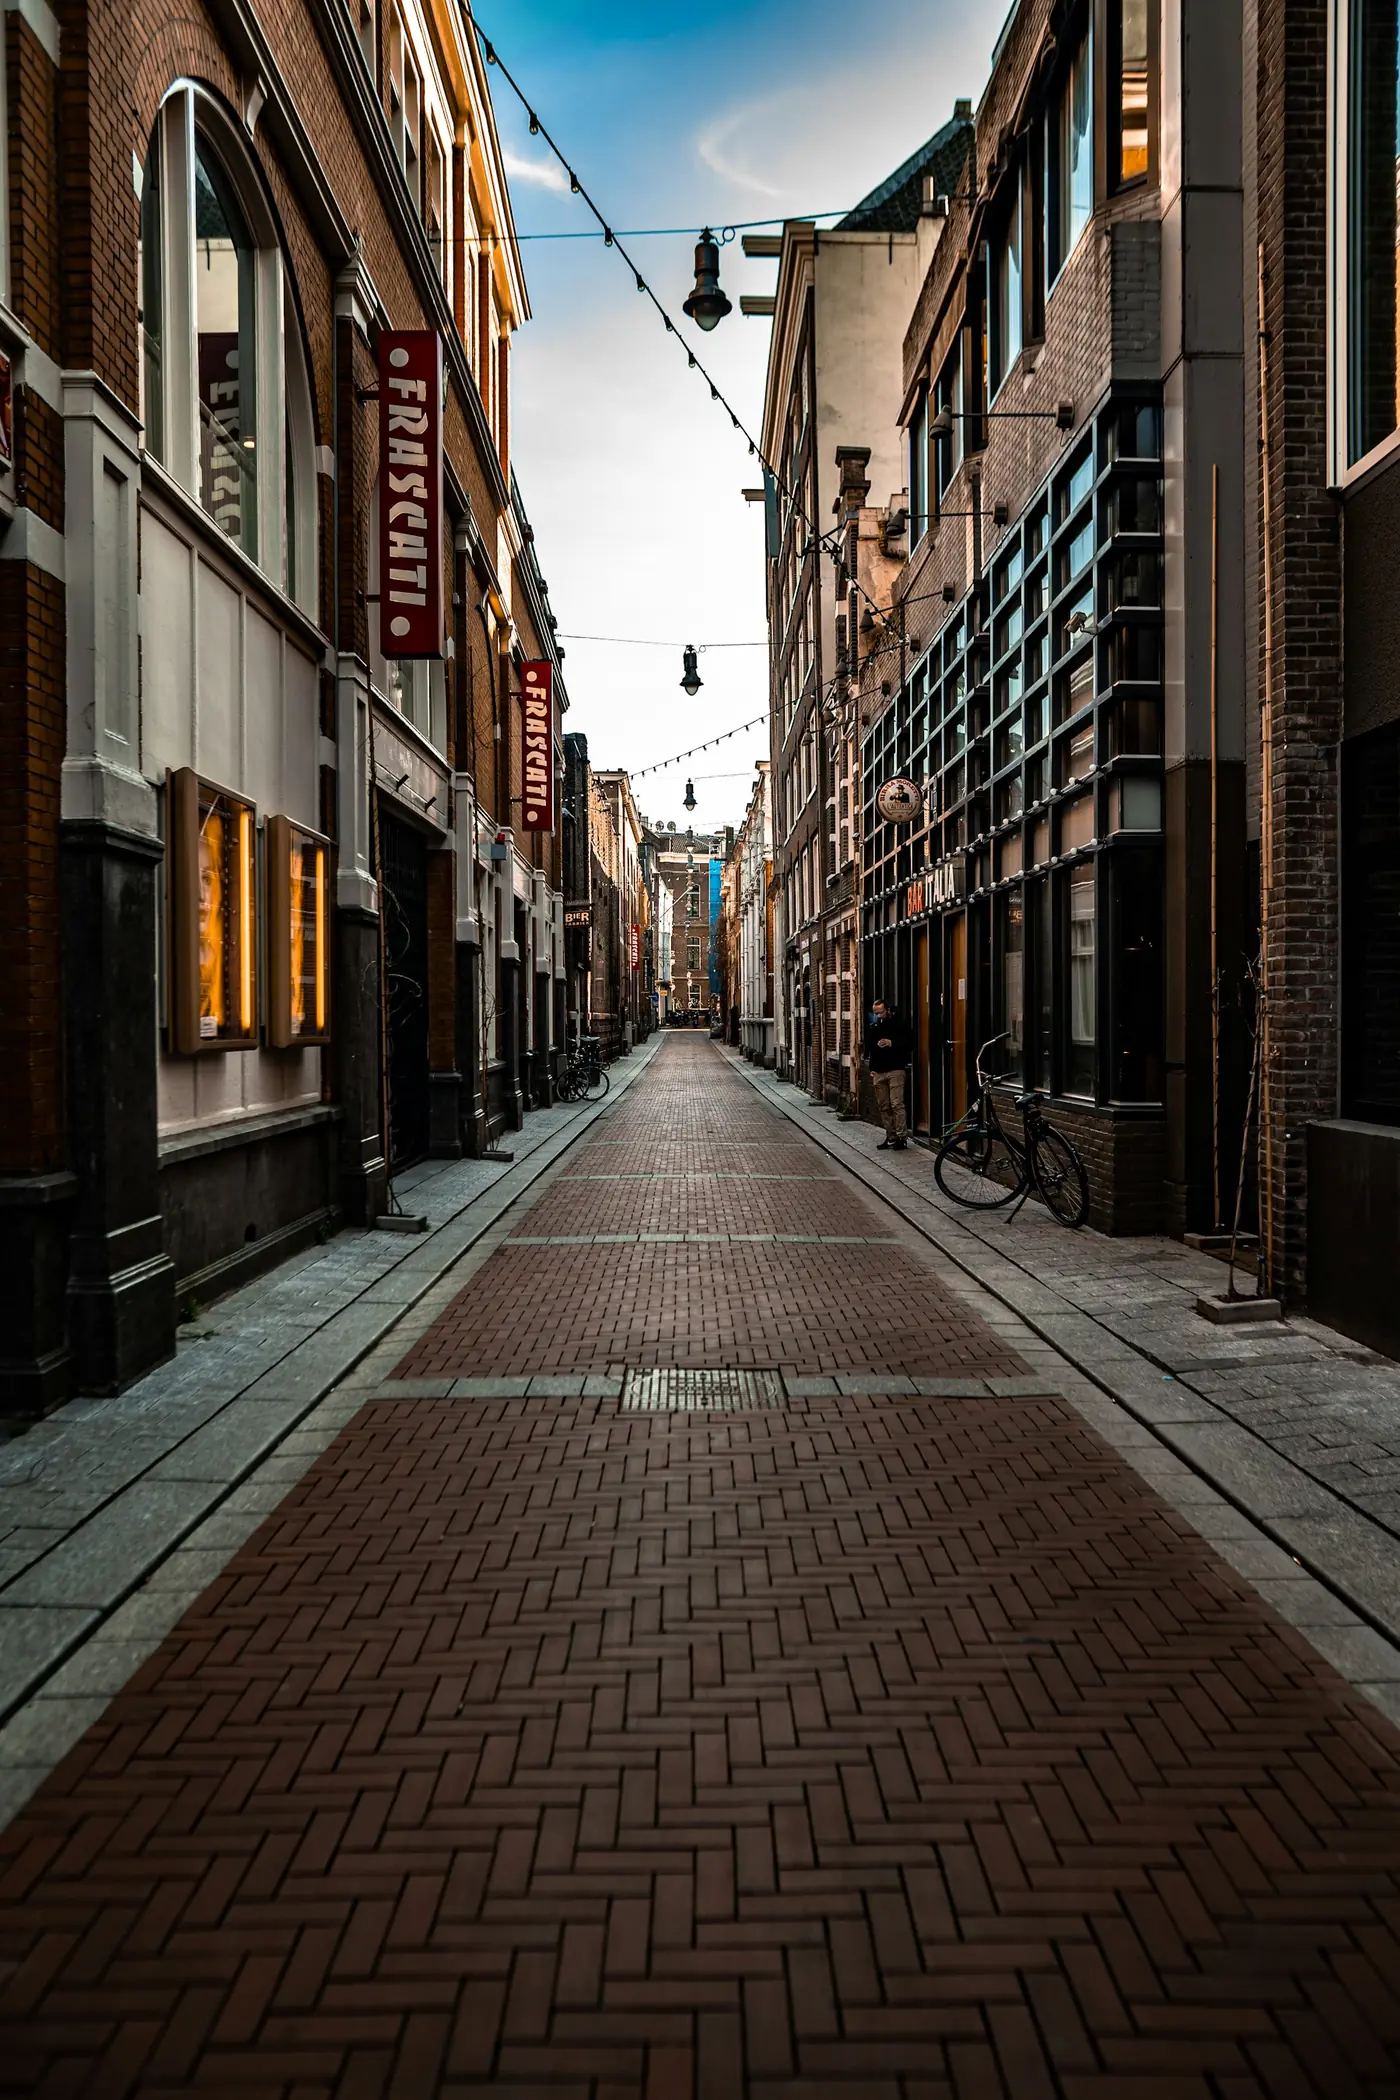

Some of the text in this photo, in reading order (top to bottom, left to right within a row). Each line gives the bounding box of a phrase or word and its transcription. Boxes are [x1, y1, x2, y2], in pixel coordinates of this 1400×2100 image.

[388, 377, 428, 606] FRASCATI
[525, 686, 548, 807] FRASCATI
[565, 912, 589, 922] BIER
[907, 863, 955, 917] BAR ITALIA
